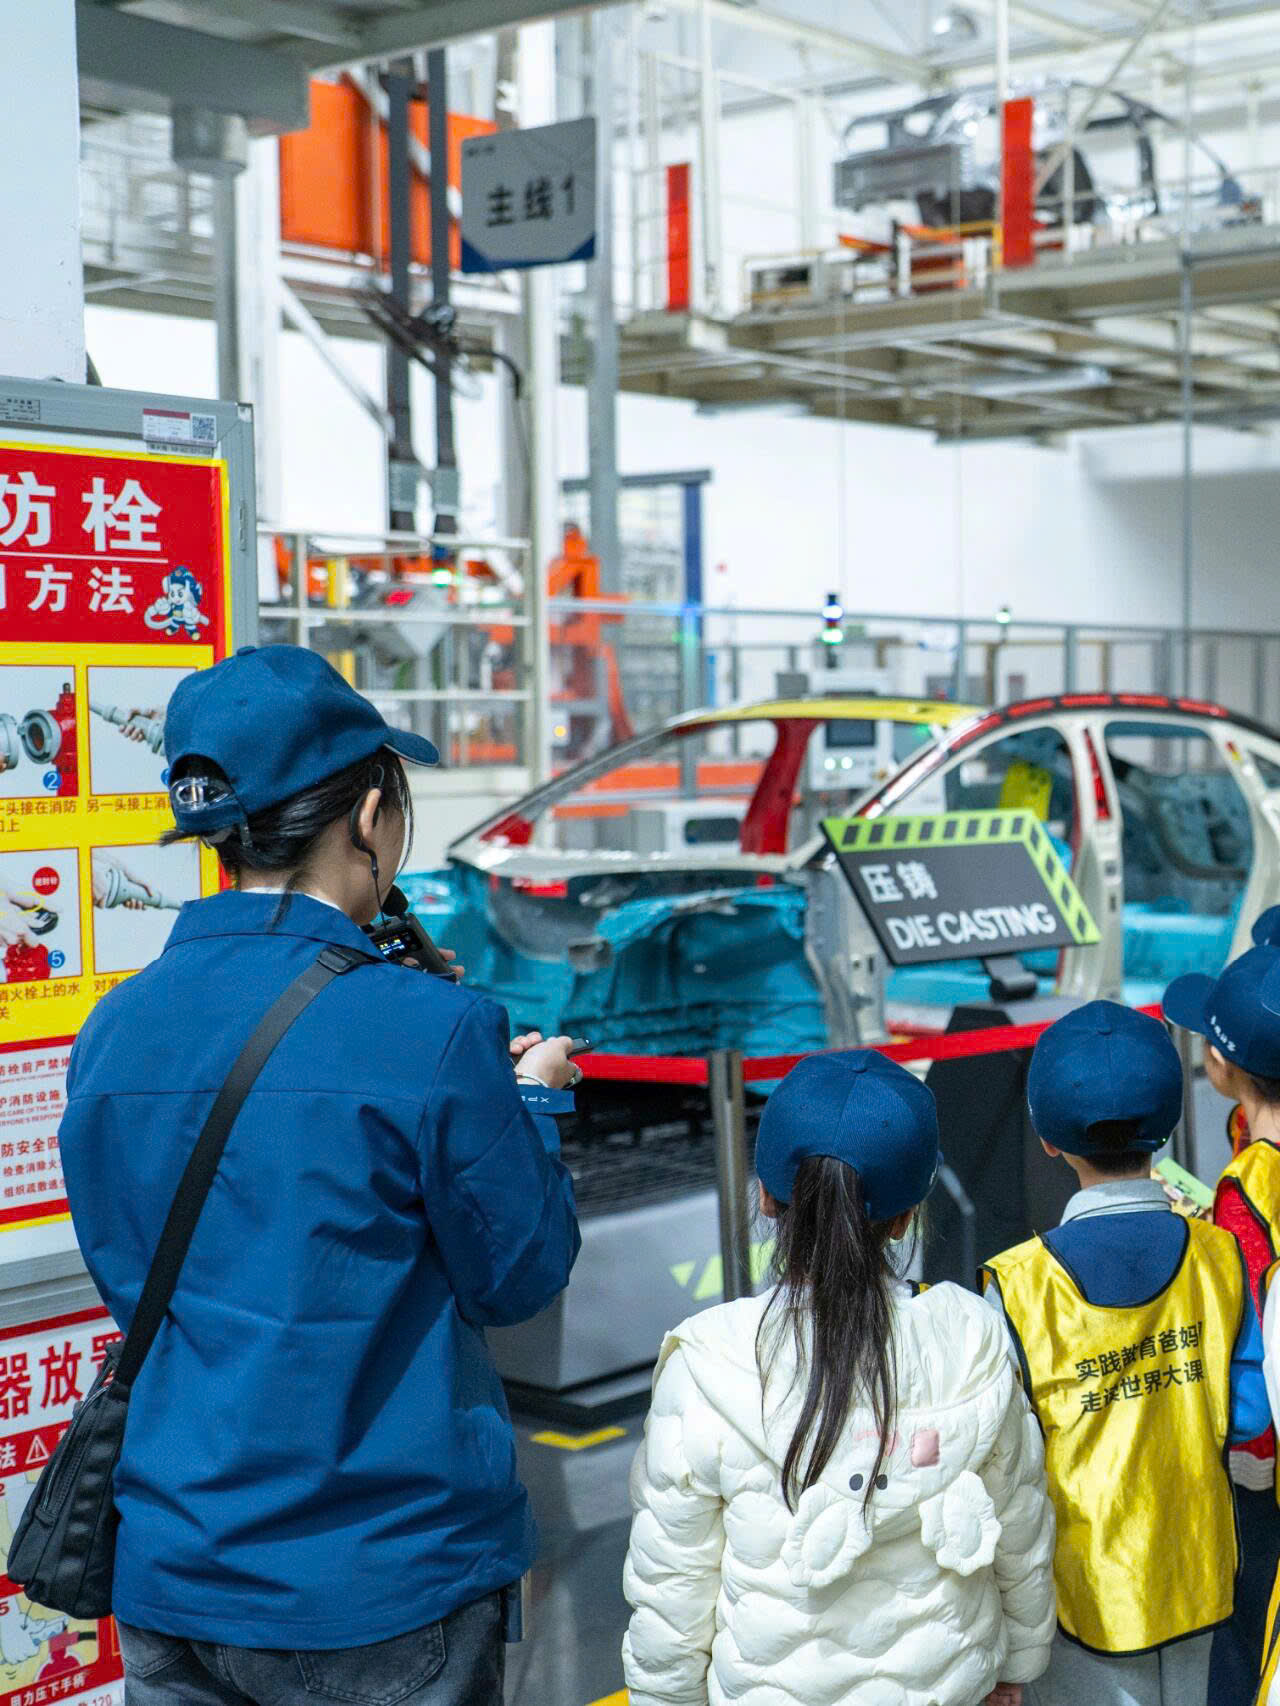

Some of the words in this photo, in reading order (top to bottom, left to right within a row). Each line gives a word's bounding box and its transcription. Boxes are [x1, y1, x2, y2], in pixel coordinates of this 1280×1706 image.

[0, 563, 134, 614] 方法
[47, 772, 58, 789] 2
[87, 796, 171, 812] 另一头接上消
[886, 915, 941, 949] DIE
[937, 903, 1056, 944] CASTING
[52, 952, 62, 966] 5
[1075, 1321, 1203, 1382] 实践教育爸妈
